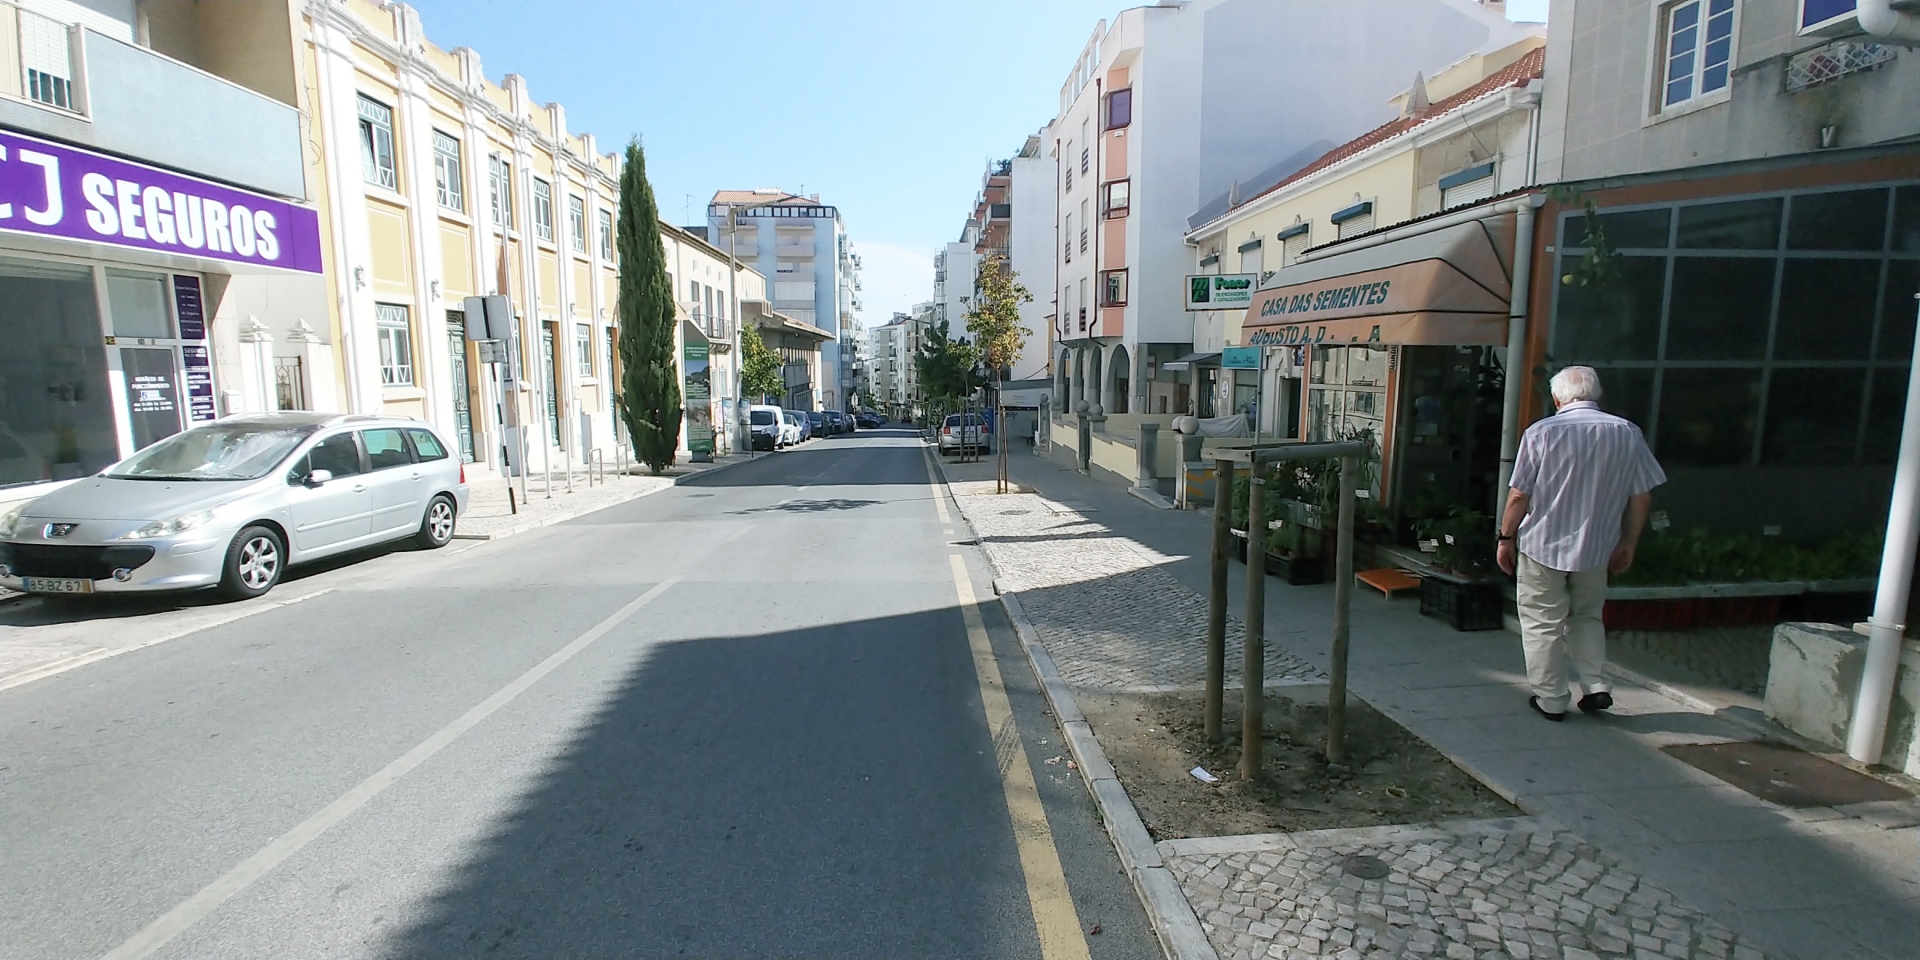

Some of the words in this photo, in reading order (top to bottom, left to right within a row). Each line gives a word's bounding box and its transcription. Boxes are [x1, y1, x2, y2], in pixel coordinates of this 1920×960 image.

[0, 144, 63, 226] J
[81, 172, 280, 260] SEGUROS
[1261, 297, 1289, 317] CASA
[1288, 293, 1313, 313] DAS
[1313, 281, 1391, 311] SEMENTES
